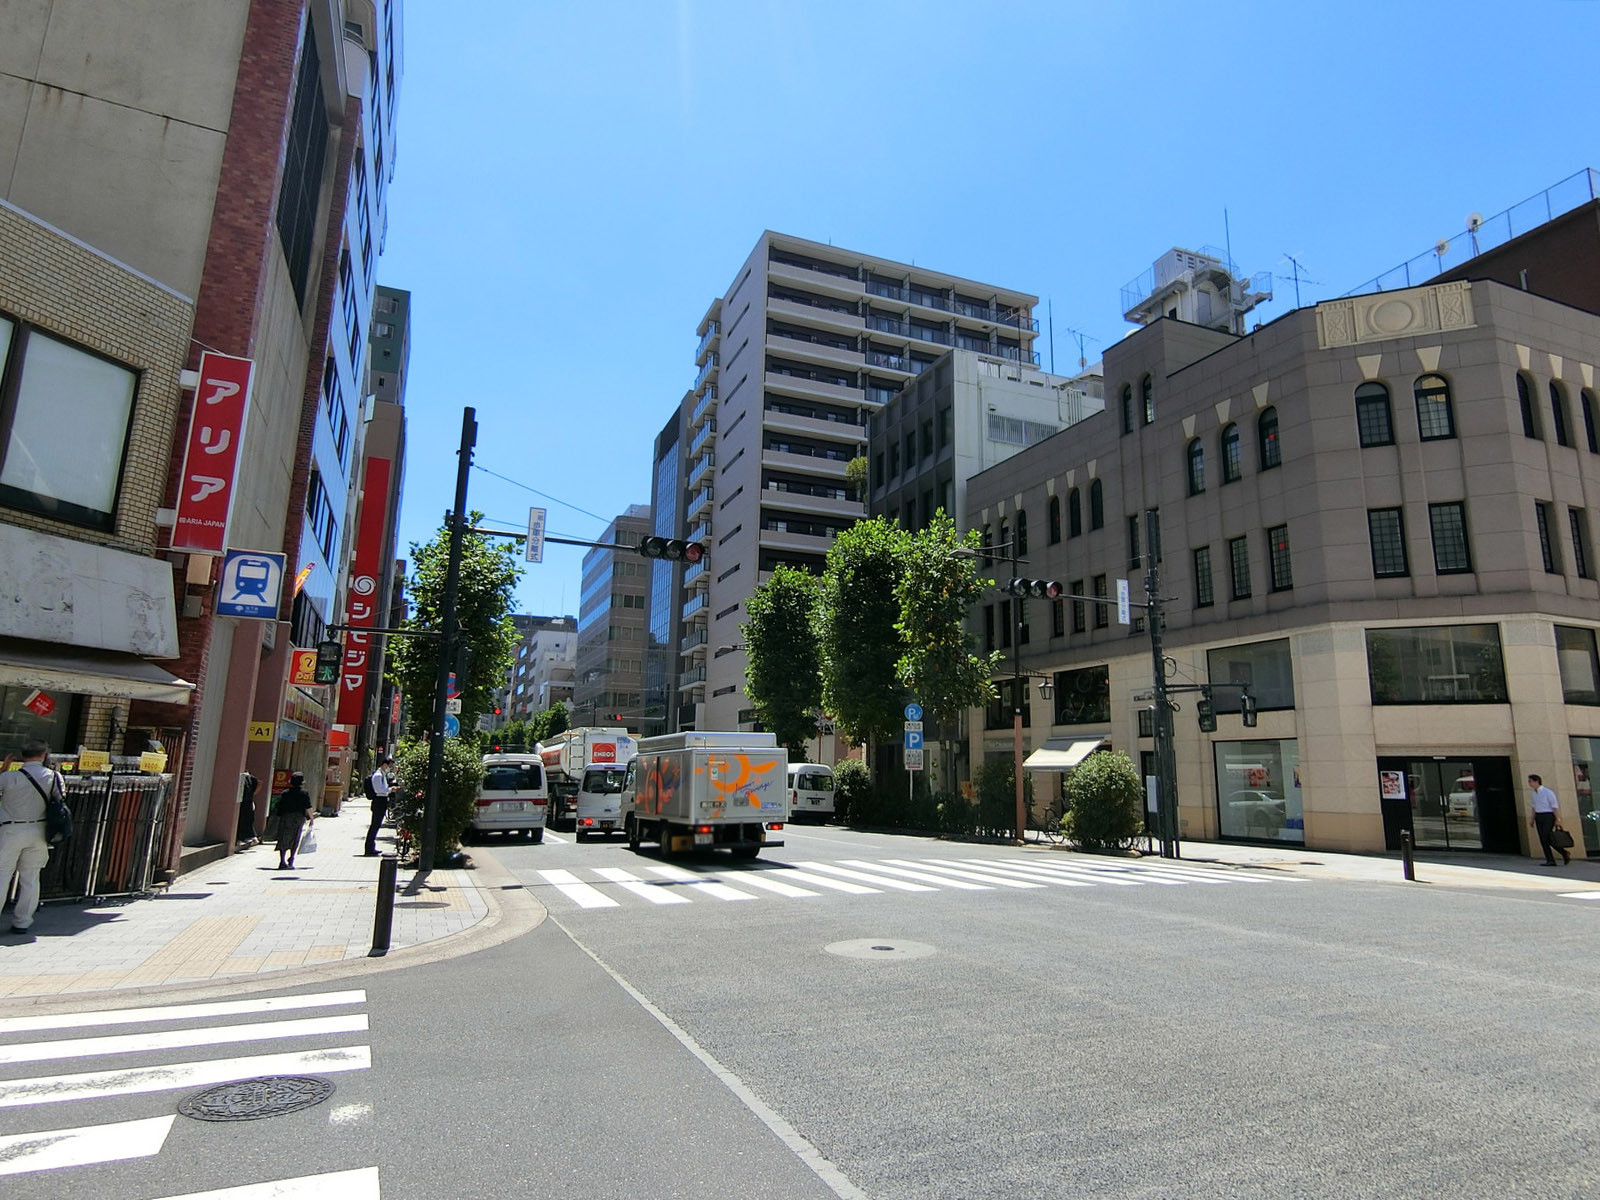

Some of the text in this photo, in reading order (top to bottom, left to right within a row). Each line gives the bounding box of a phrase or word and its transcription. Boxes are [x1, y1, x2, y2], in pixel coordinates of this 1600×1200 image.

[191, 378, 241, 502] アリア
[186, 518, 226, 528] ARIA JAPAN
[345, 602, 371, 691] シモジマ
[255, 727, 270, 737] A1
[910, 733, 920, 748] P
